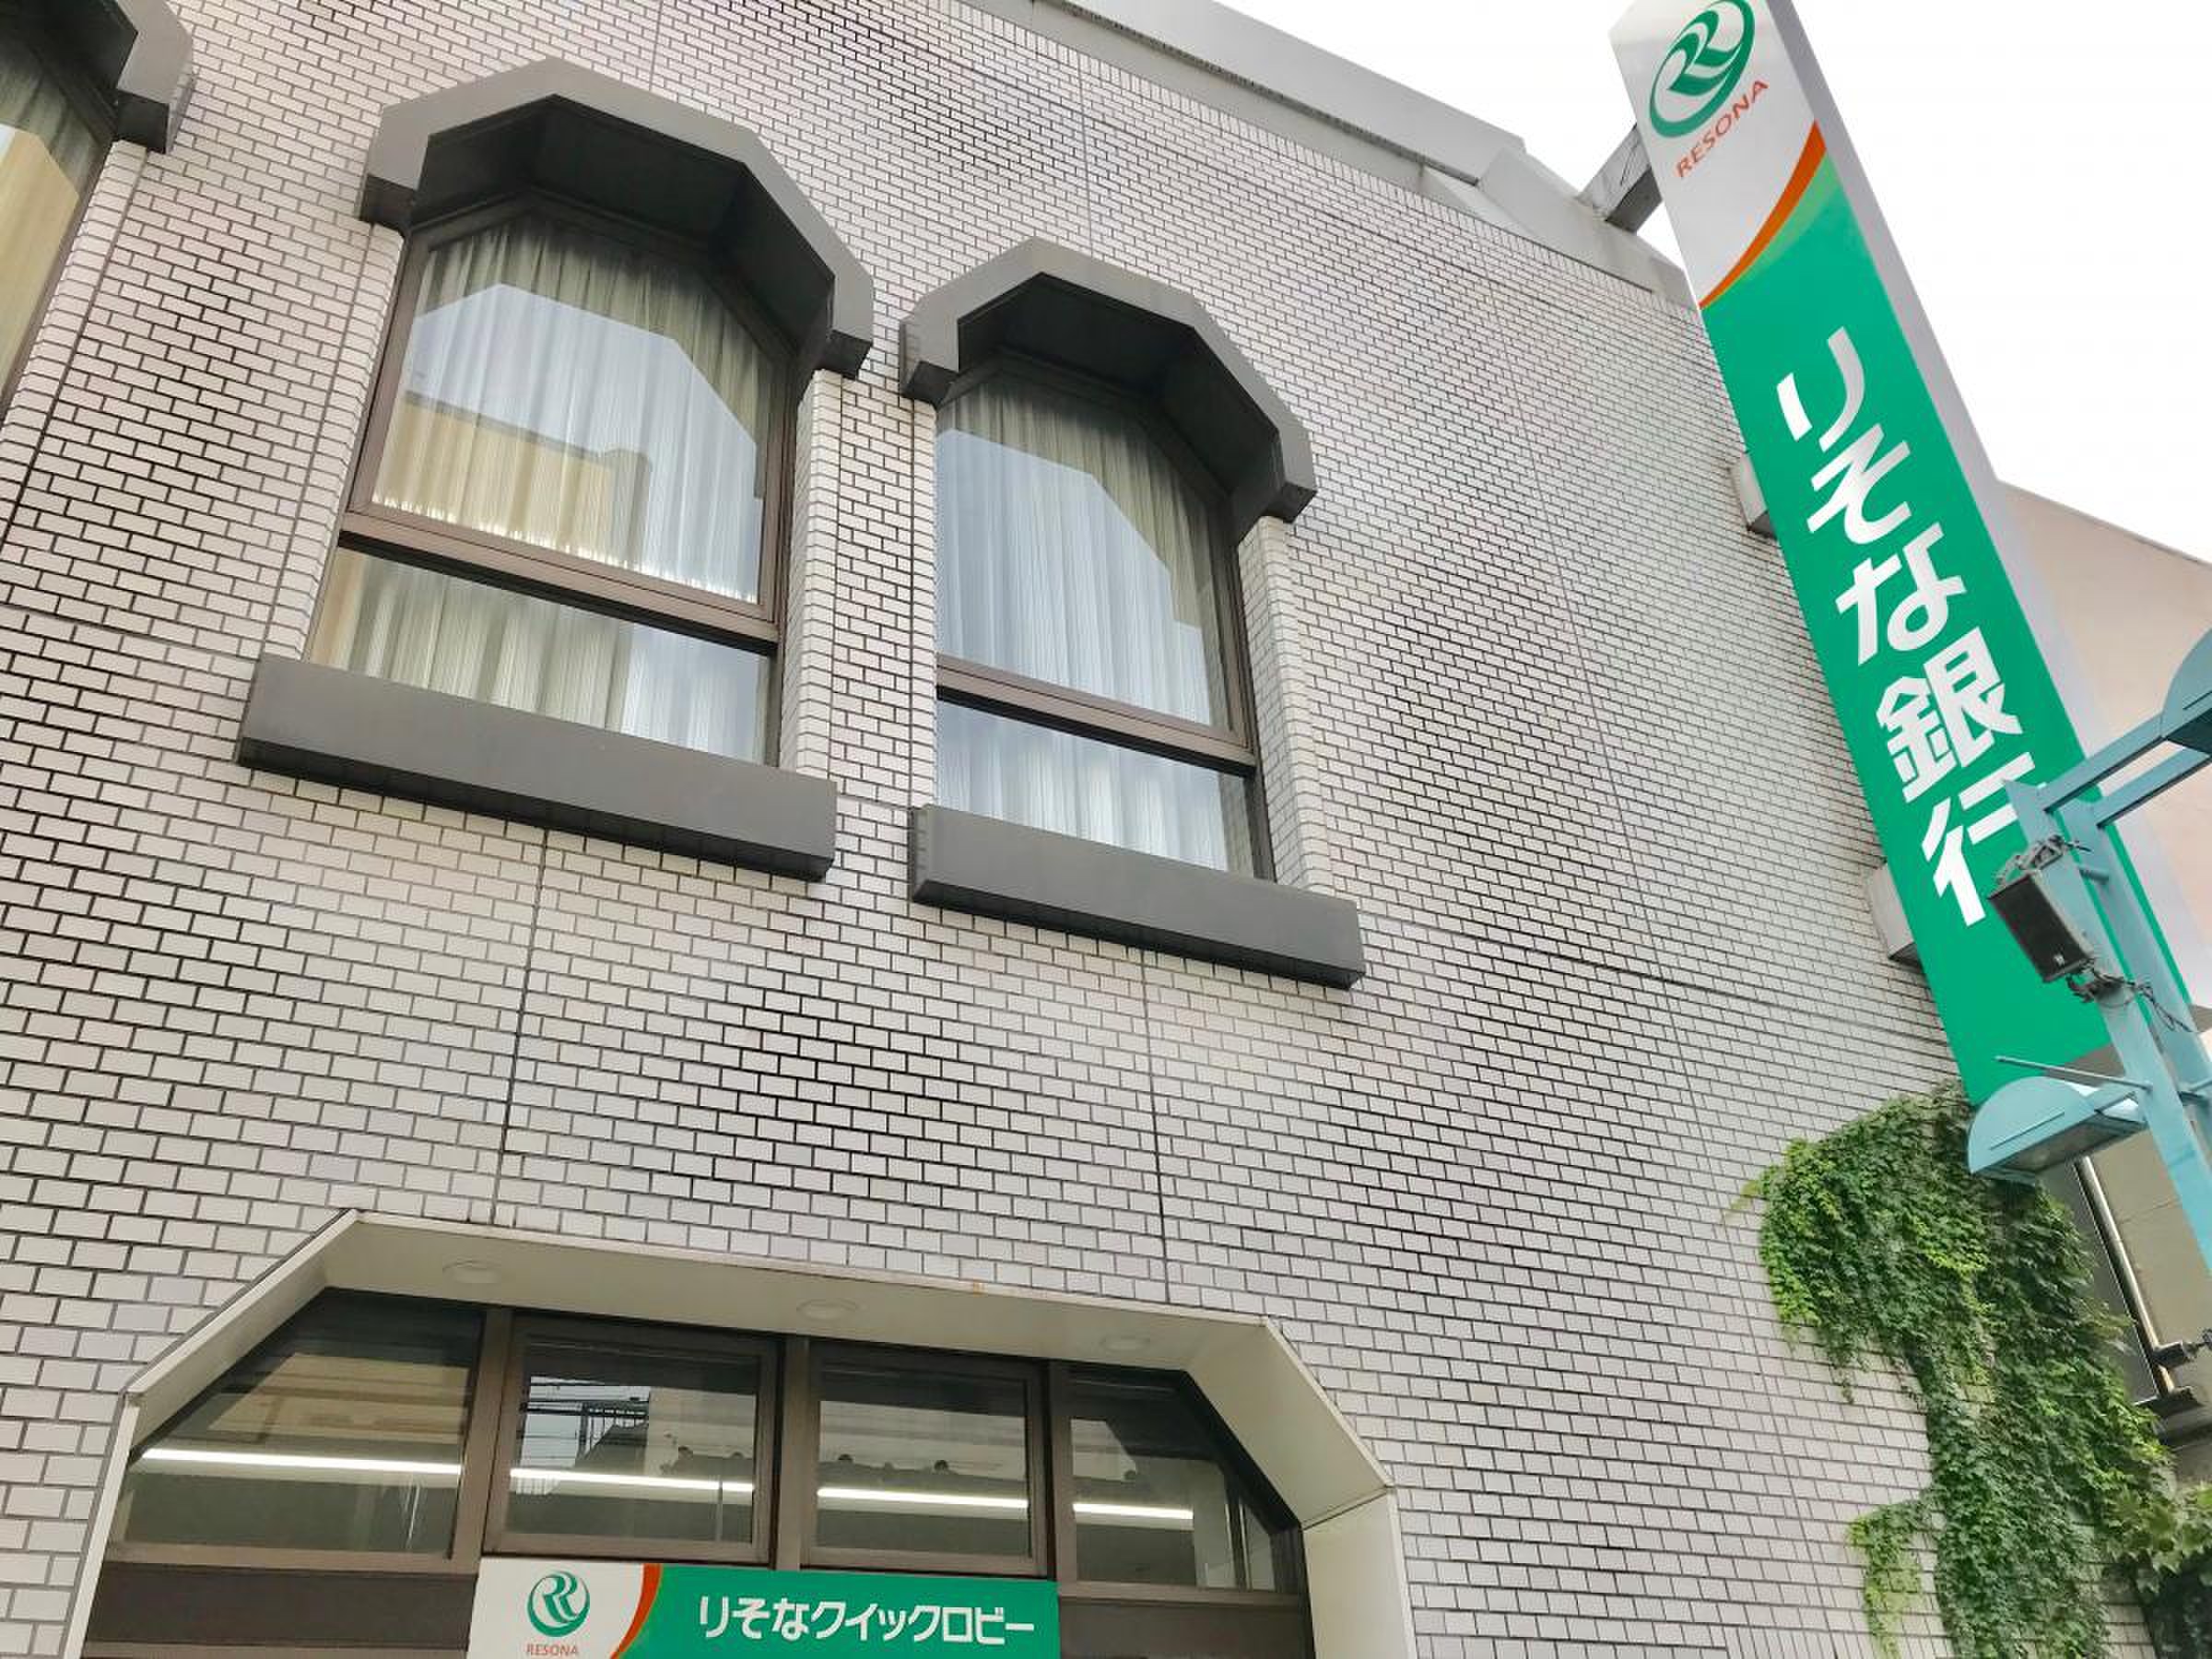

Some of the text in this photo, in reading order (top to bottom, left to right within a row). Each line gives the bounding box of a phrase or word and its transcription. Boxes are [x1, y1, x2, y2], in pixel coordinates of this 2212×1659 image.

[1676, 80, 1769, 178] RESONA
[700, 1595, 1034, 1645] りそなクイックロビー
[526, 1643, 579, 1656] RESONA
